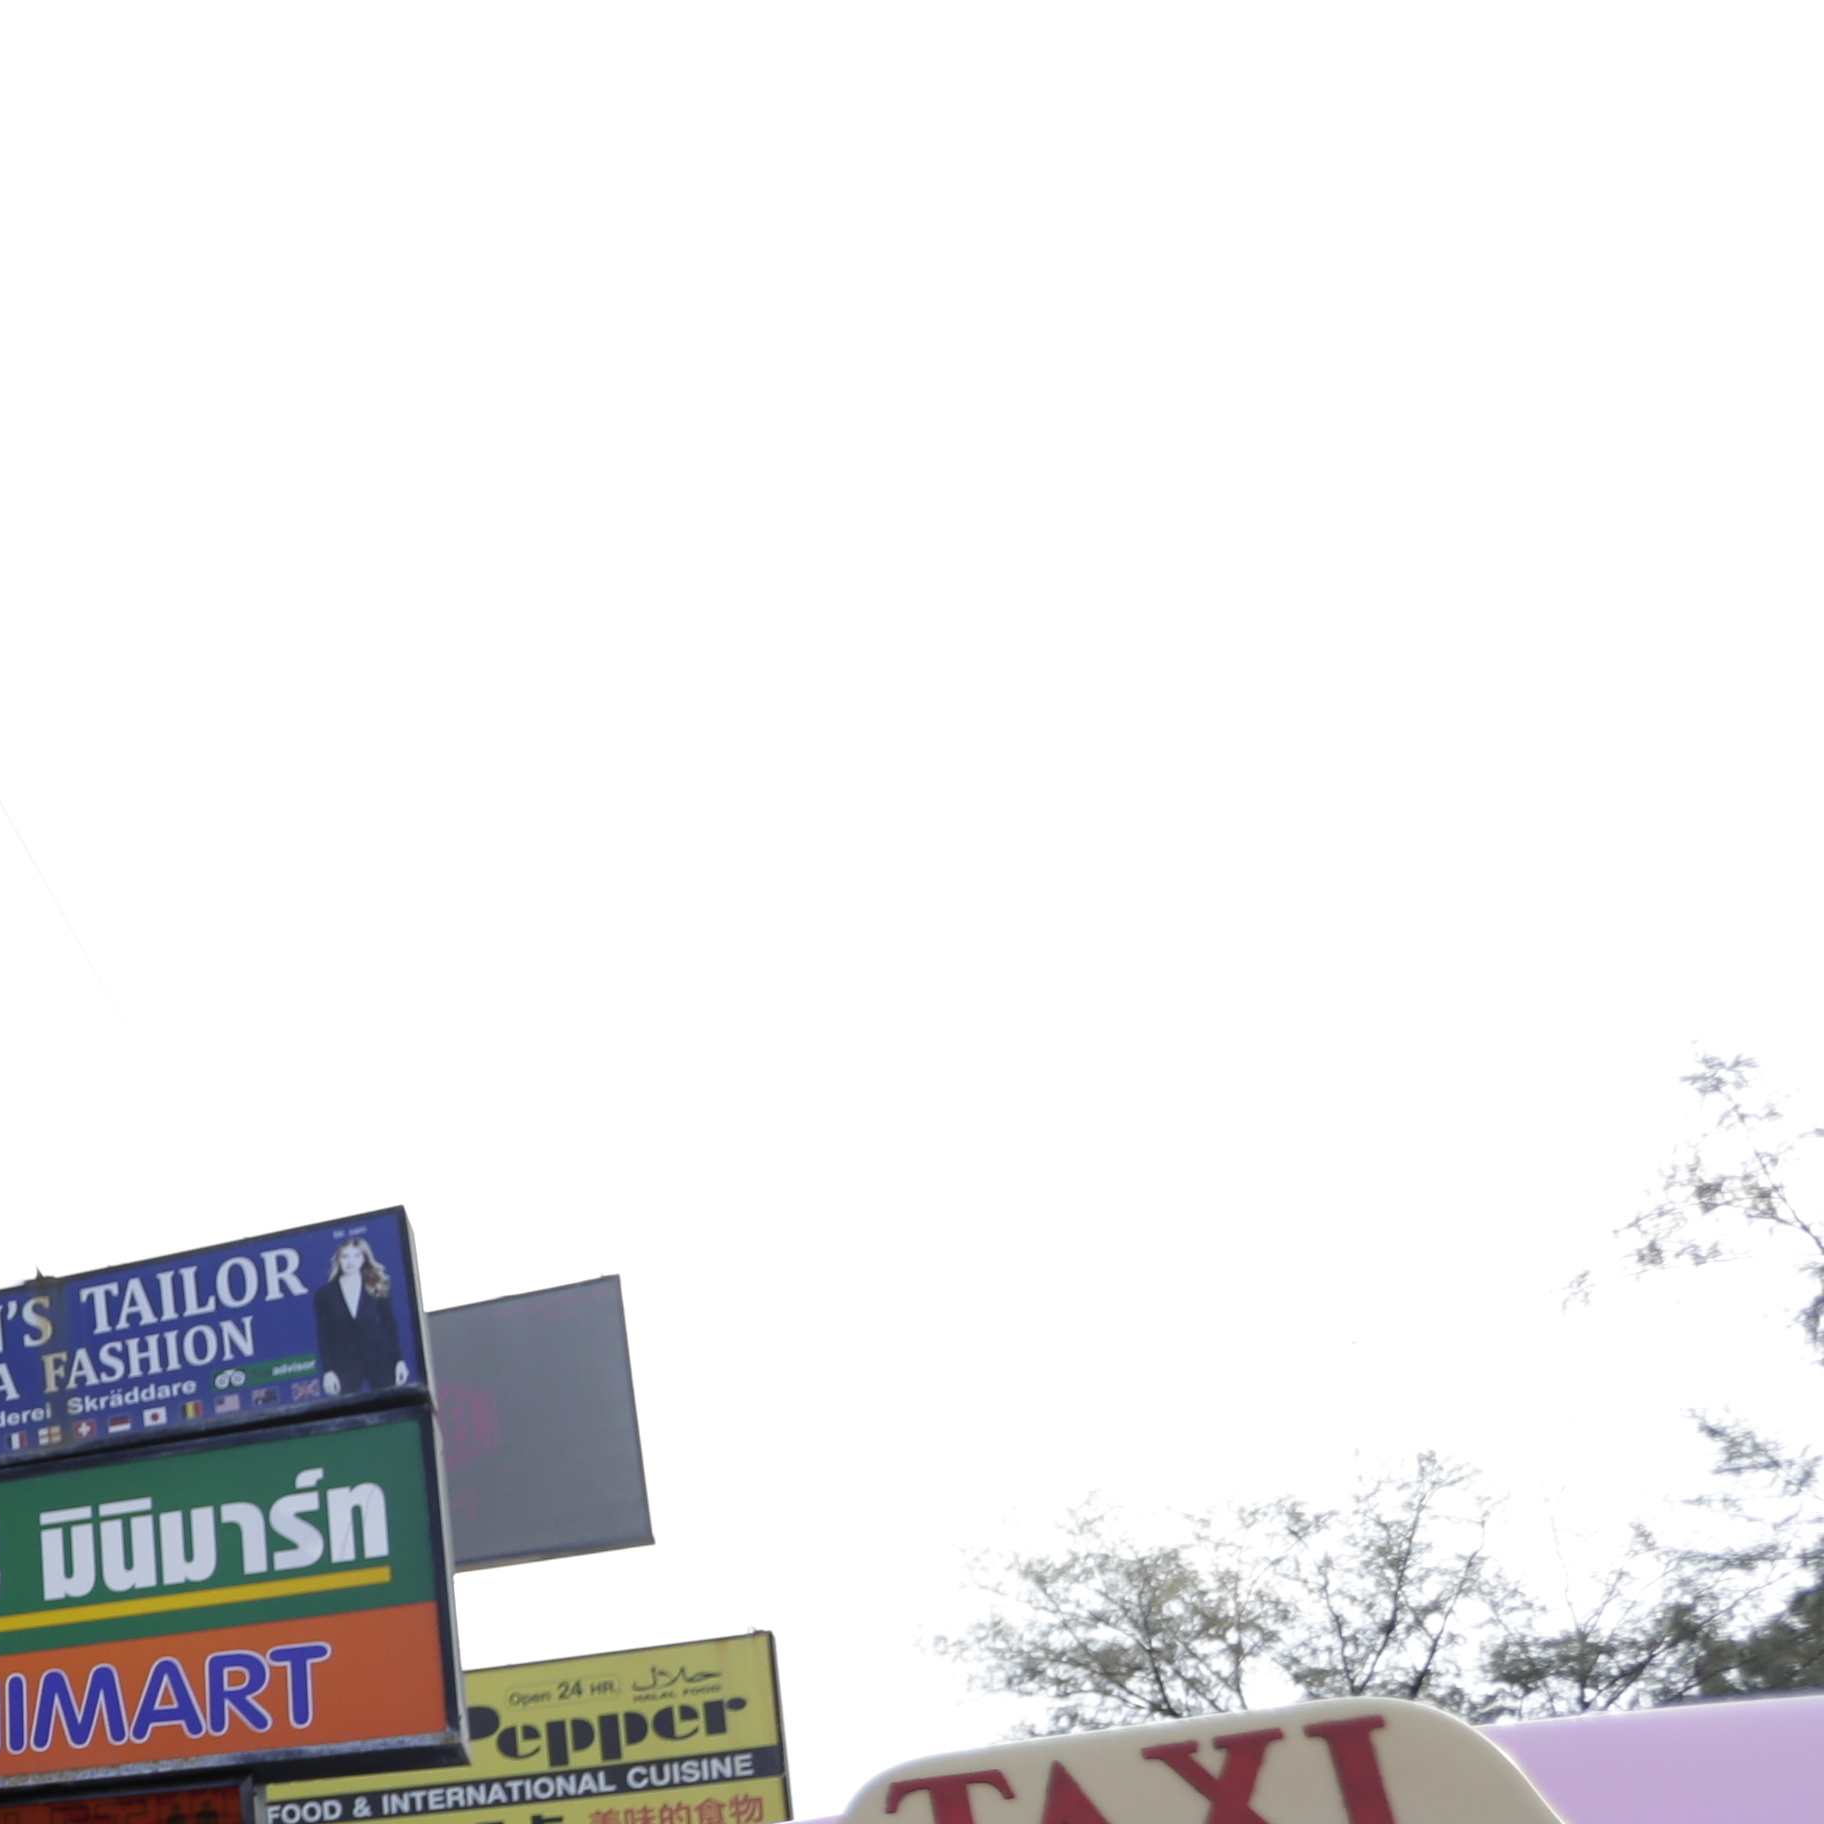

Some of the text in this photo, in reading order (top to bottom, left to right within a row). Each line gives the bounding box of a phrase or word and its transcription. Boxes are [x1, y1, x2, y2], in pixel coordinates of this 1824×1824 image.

[79, 1247, 310, 1336] TAILOR
[43, 1315, 254, 1395] FASHION
[66, 1380, 198, 1417] Skräddare
[38, 1466, 391, 1601] มินิมาร์ท
[557, 1680, 583, 1701] 24
[352, 1796, 373, 1817] &
[381, 1769, 618, 1814] INTERNATIONAL
[626, 1754, 755, 1789] CUISINE
